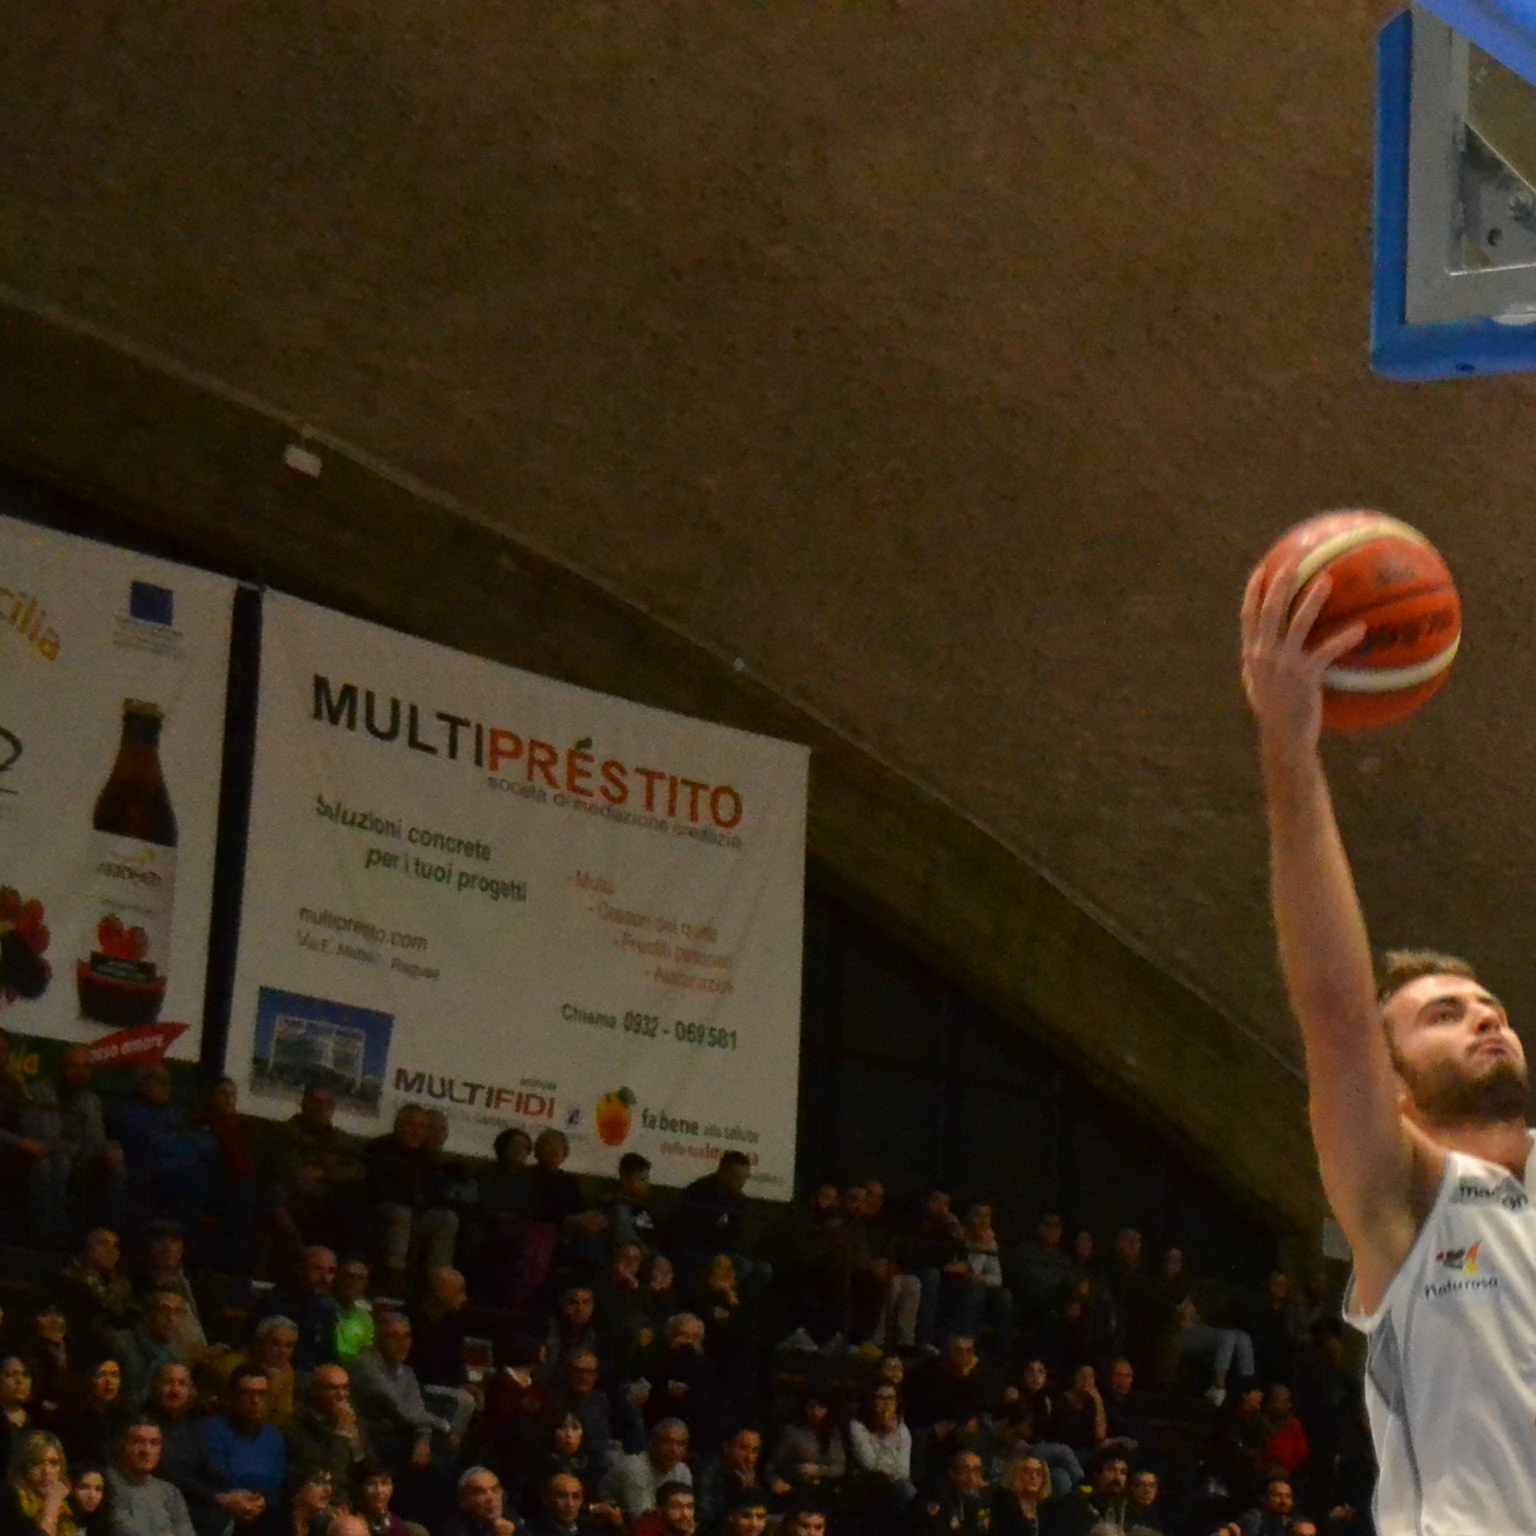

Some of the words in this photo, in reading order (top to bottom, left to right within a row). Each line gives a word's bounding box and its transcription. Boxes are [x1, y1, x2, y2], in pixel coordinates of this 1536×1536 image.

[407, 827, 492, 862] concrete
[364, 847, 399, 870] per
[414, 857, 452, 884] tuoi
[456, 870, 528, 902] progetti
[623, 1010, 660, 1038] 0932
[394, 1067, 557, 1119] MULTIFIDI
